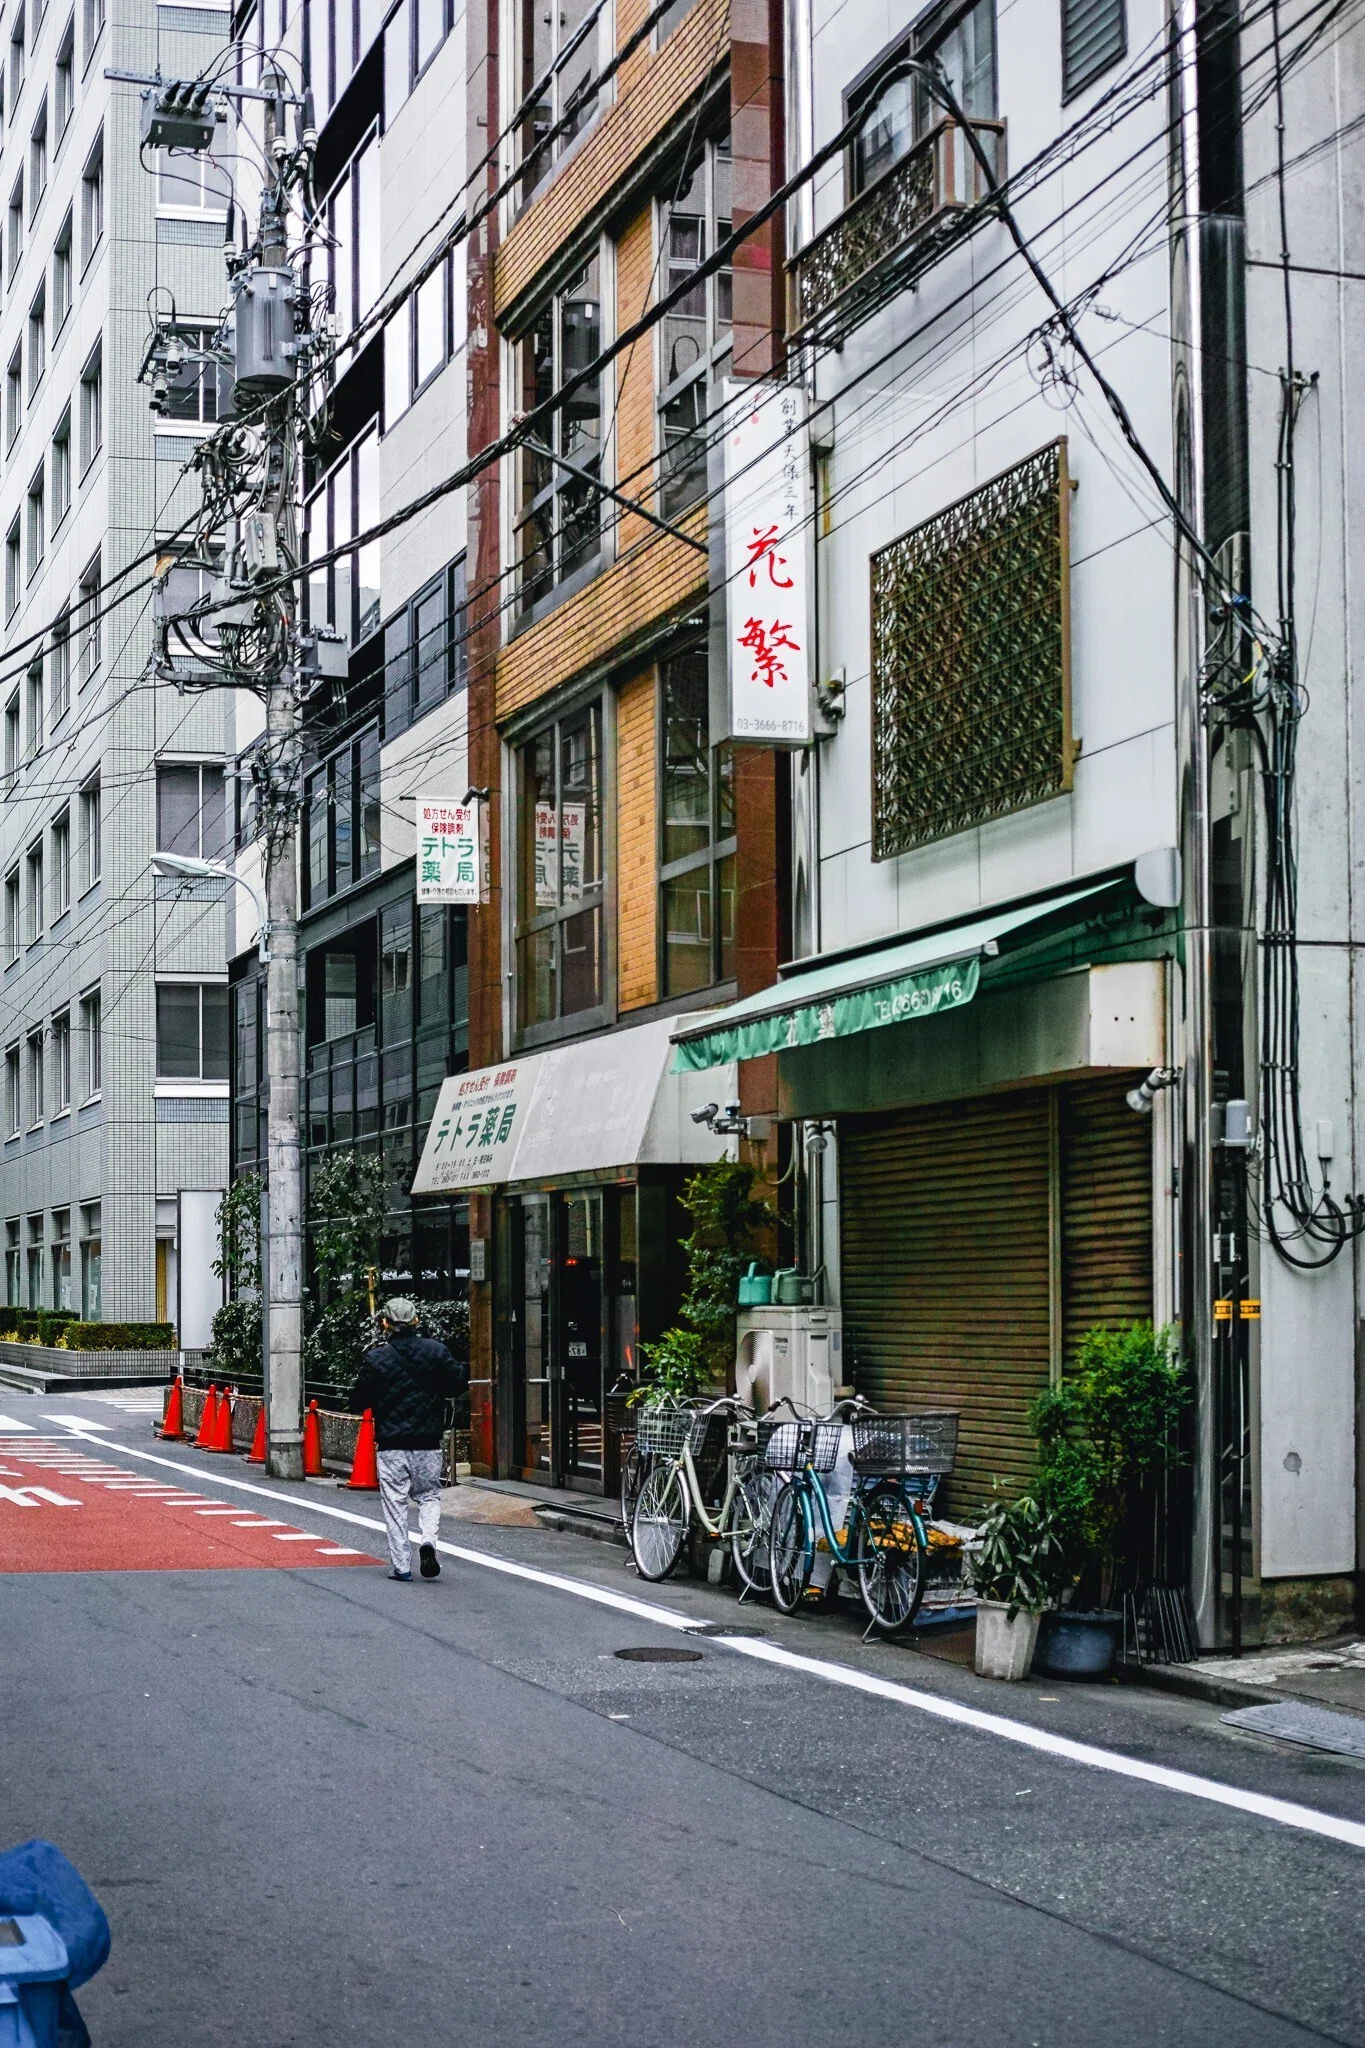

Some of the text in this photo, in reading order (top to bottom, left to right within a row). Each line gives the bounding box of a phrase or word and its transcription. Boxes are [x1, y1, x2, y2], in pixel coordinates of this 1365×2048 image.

[736, 524, 802, 689] 花繁
[736, 718, 805, 733] 03-3666-8716
[423, 807, 472, 821] 処方せん受付
[431, 822, 464, 836] 保険調剤
[421, 836, 475, 858] テトラ
[434, 1103, 517, 1154] テトラ薬局
